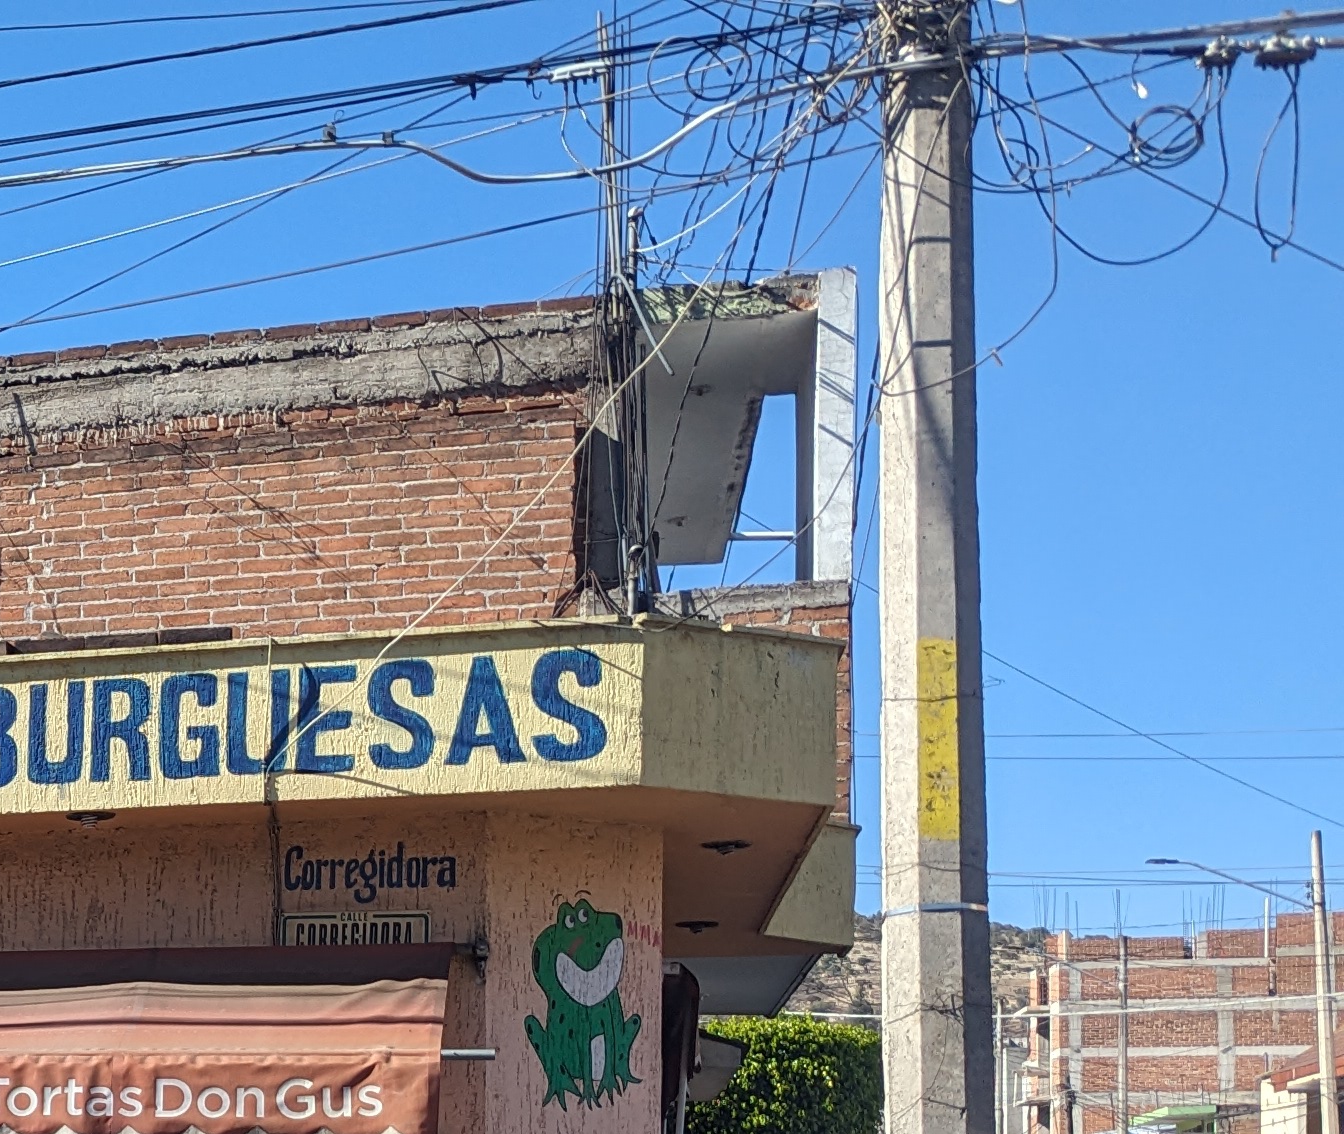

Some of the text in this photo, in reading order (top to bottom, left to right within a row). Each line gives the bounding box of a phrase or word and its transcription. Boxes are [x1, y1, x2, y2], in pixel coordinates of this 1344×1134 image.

[284, 841, 457, 904] Corregidora
[340, 911, 368, 922] CALLE
[155, 1078, 265, 1118] Don
[275, 1078, 383, 1119] Gus
